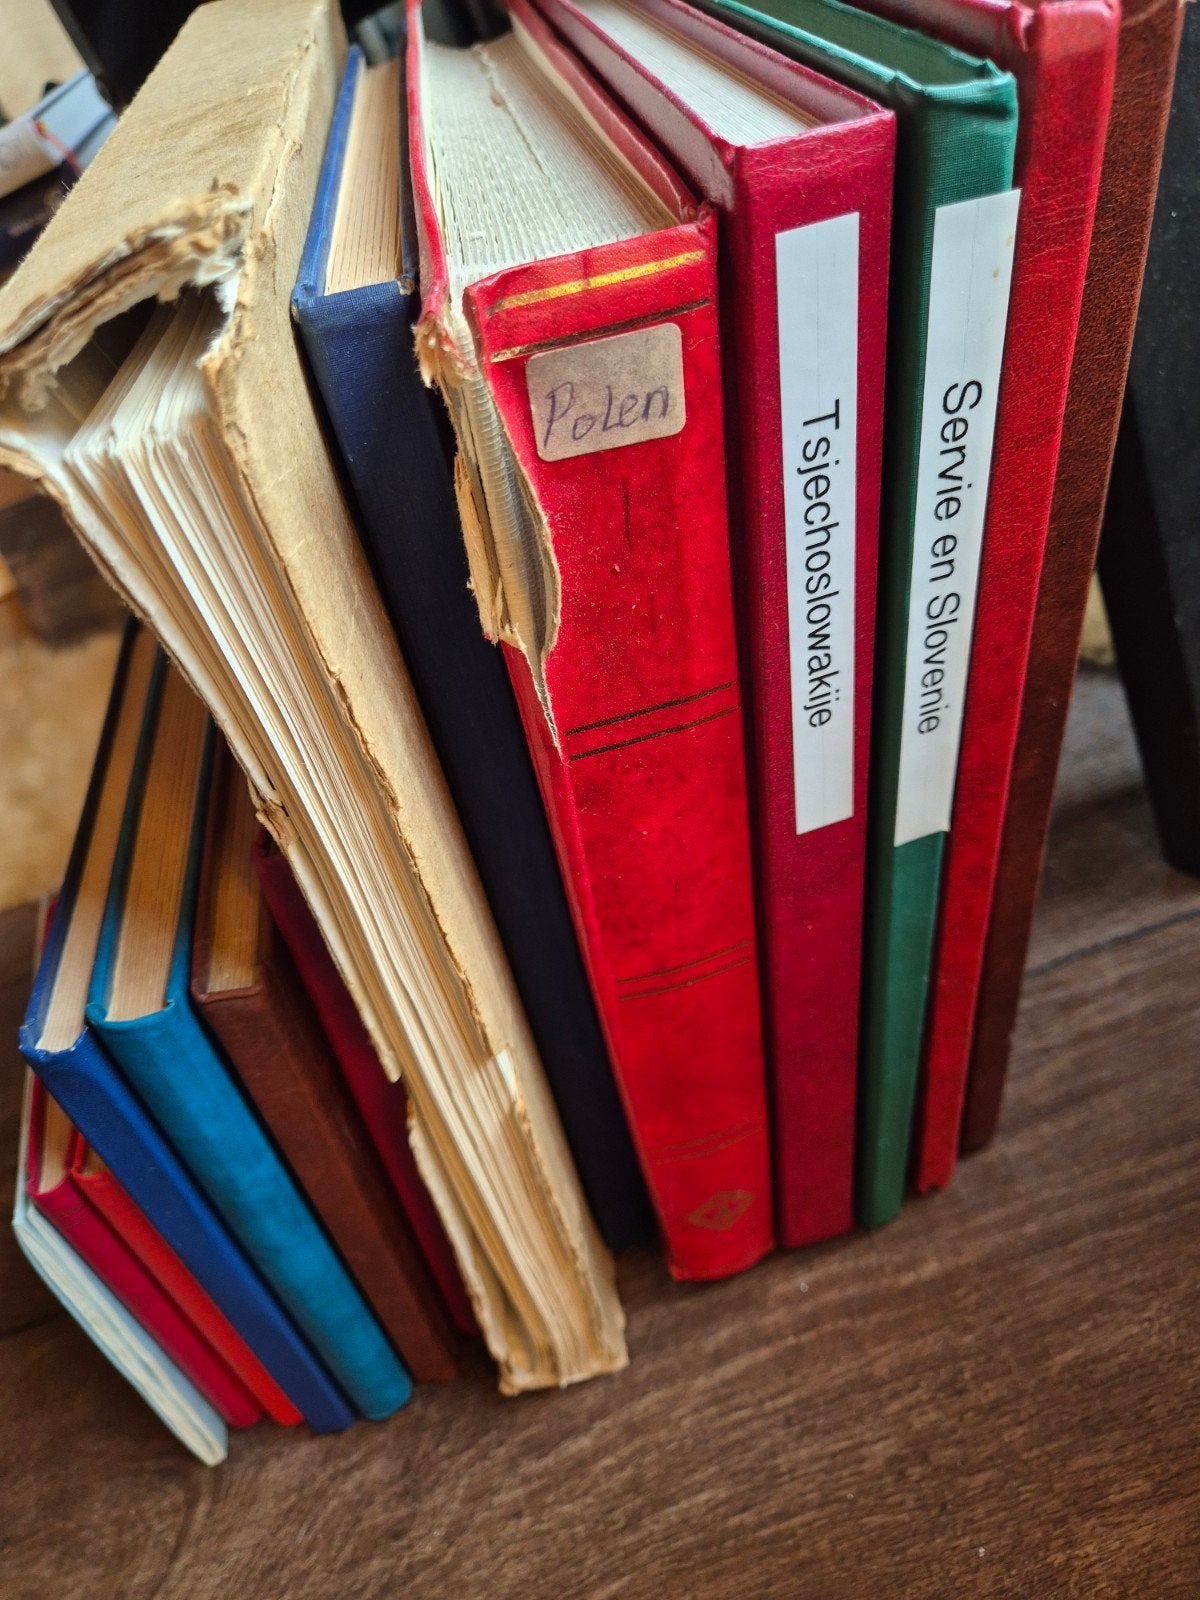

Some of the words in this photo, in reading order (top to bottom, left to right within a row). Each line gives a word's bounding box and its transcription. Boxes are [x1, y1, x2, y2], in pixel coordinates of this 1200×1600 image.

[933, 379, 983, 522] Servie
[796, 398, 840, 729] Tsjechoslowakije
[929, 534, 958, 583] en
[917, 592, 961, 735] Slovenie
